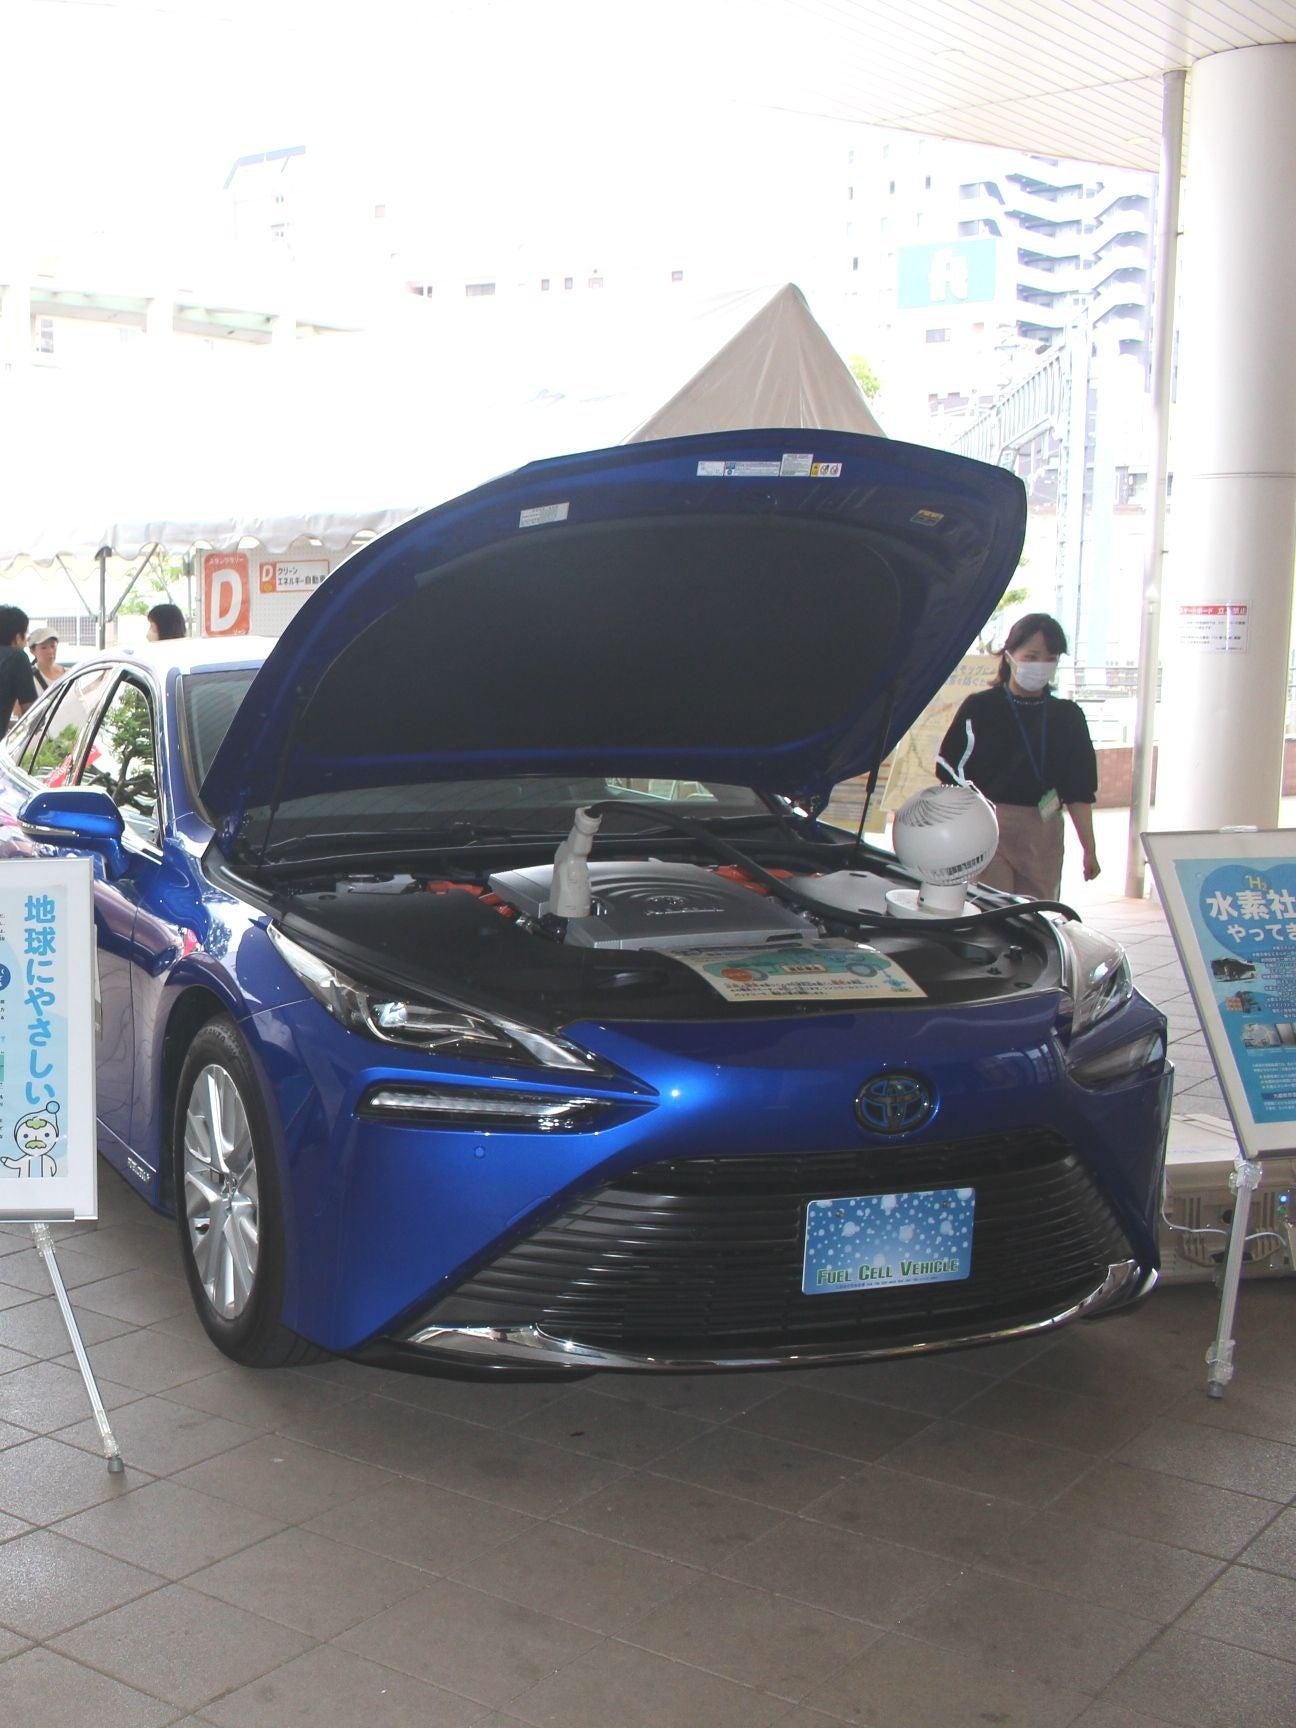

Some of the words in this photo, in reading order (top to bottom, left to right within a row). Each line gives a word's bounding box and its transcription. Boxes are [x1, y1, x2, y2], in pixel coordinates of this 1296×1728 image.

[262, 564, 273, 581] D
[210, 568, 243, 632] D
[23, 895, 56, 1106] 地球にやさしい
[816, 1268, 851, 1285] FUEL
[858, 1263, 893, 1281] CELL
[900, 1258, 960, 1276] VEHICLE
